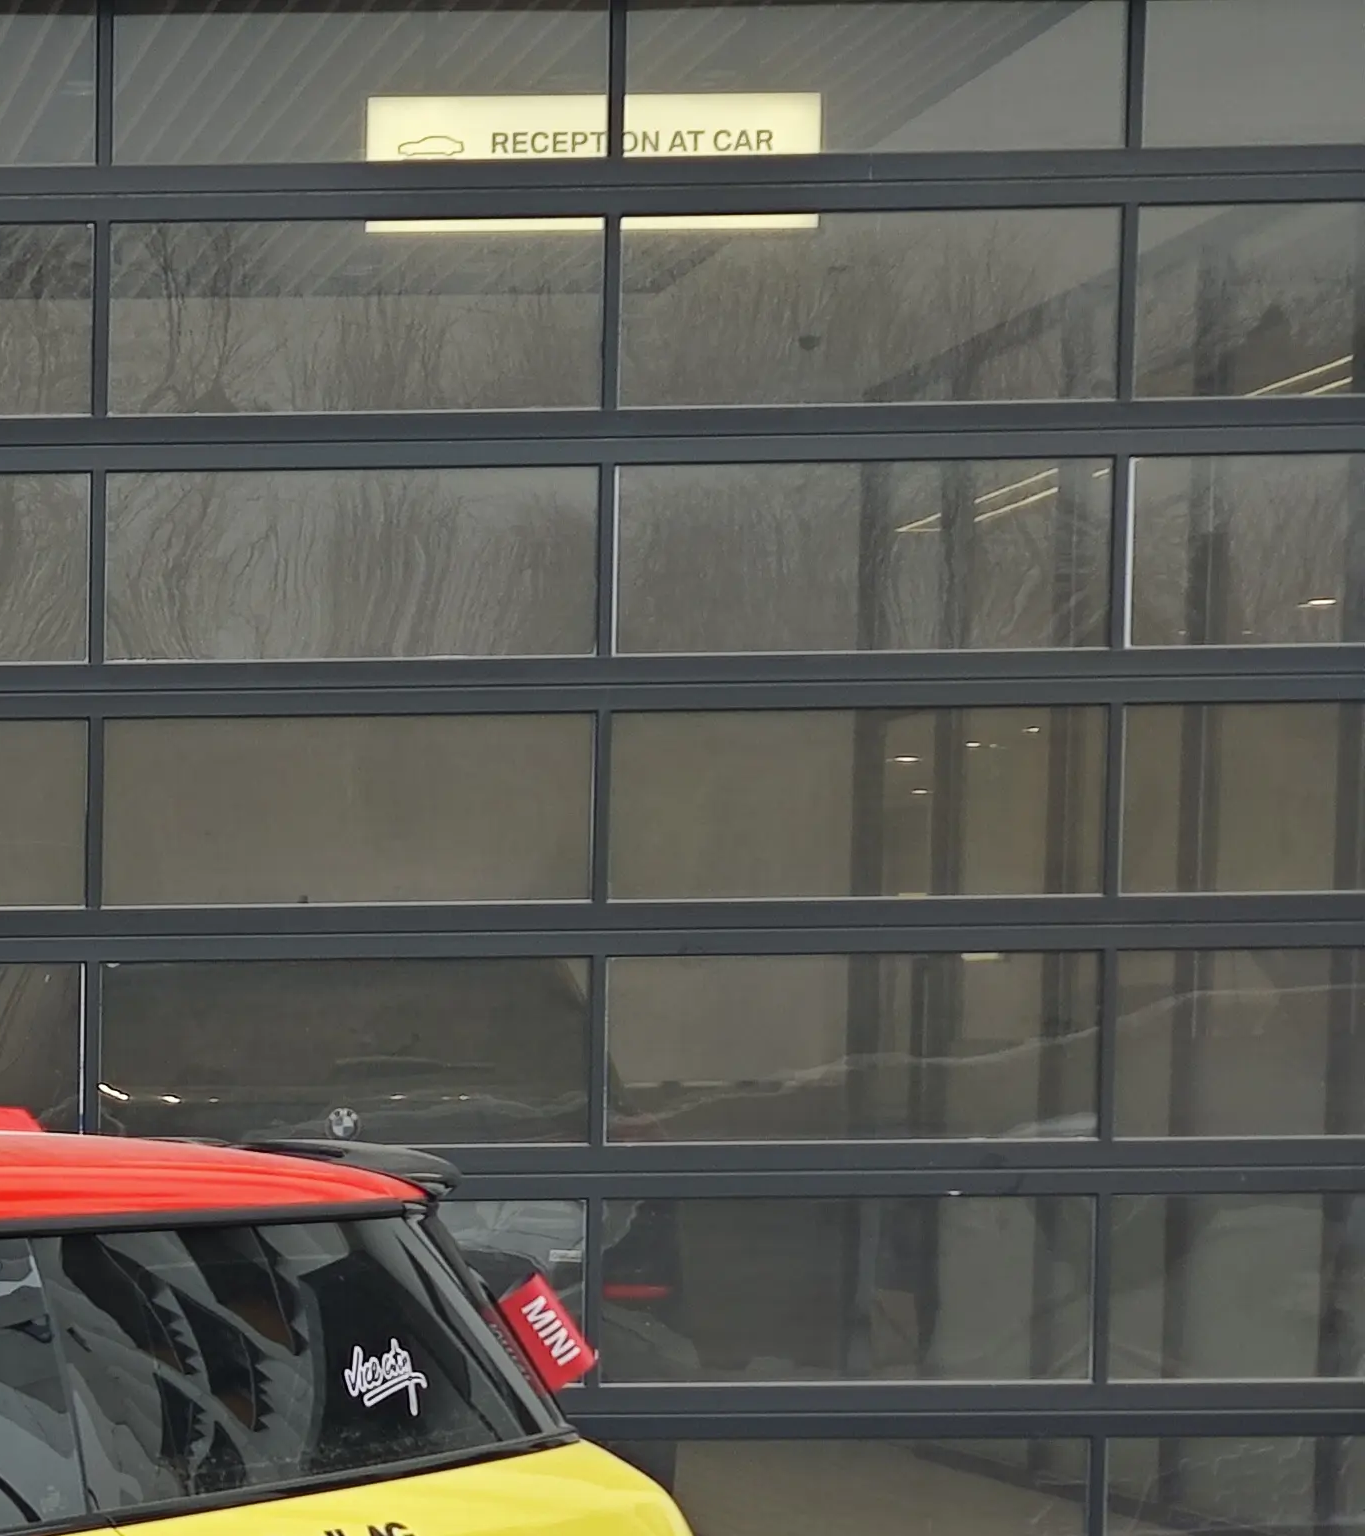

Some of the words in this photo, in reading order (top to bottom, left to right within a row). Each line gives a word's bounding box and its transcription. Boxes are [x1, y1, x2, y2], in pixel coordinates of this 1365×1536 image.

[490, 129, 661, 154] RECEPTON
[669, 130, 705, 152] AT
[713, 129, 774, 152] CAR
[520, 1294, 582, 1367] MINI
